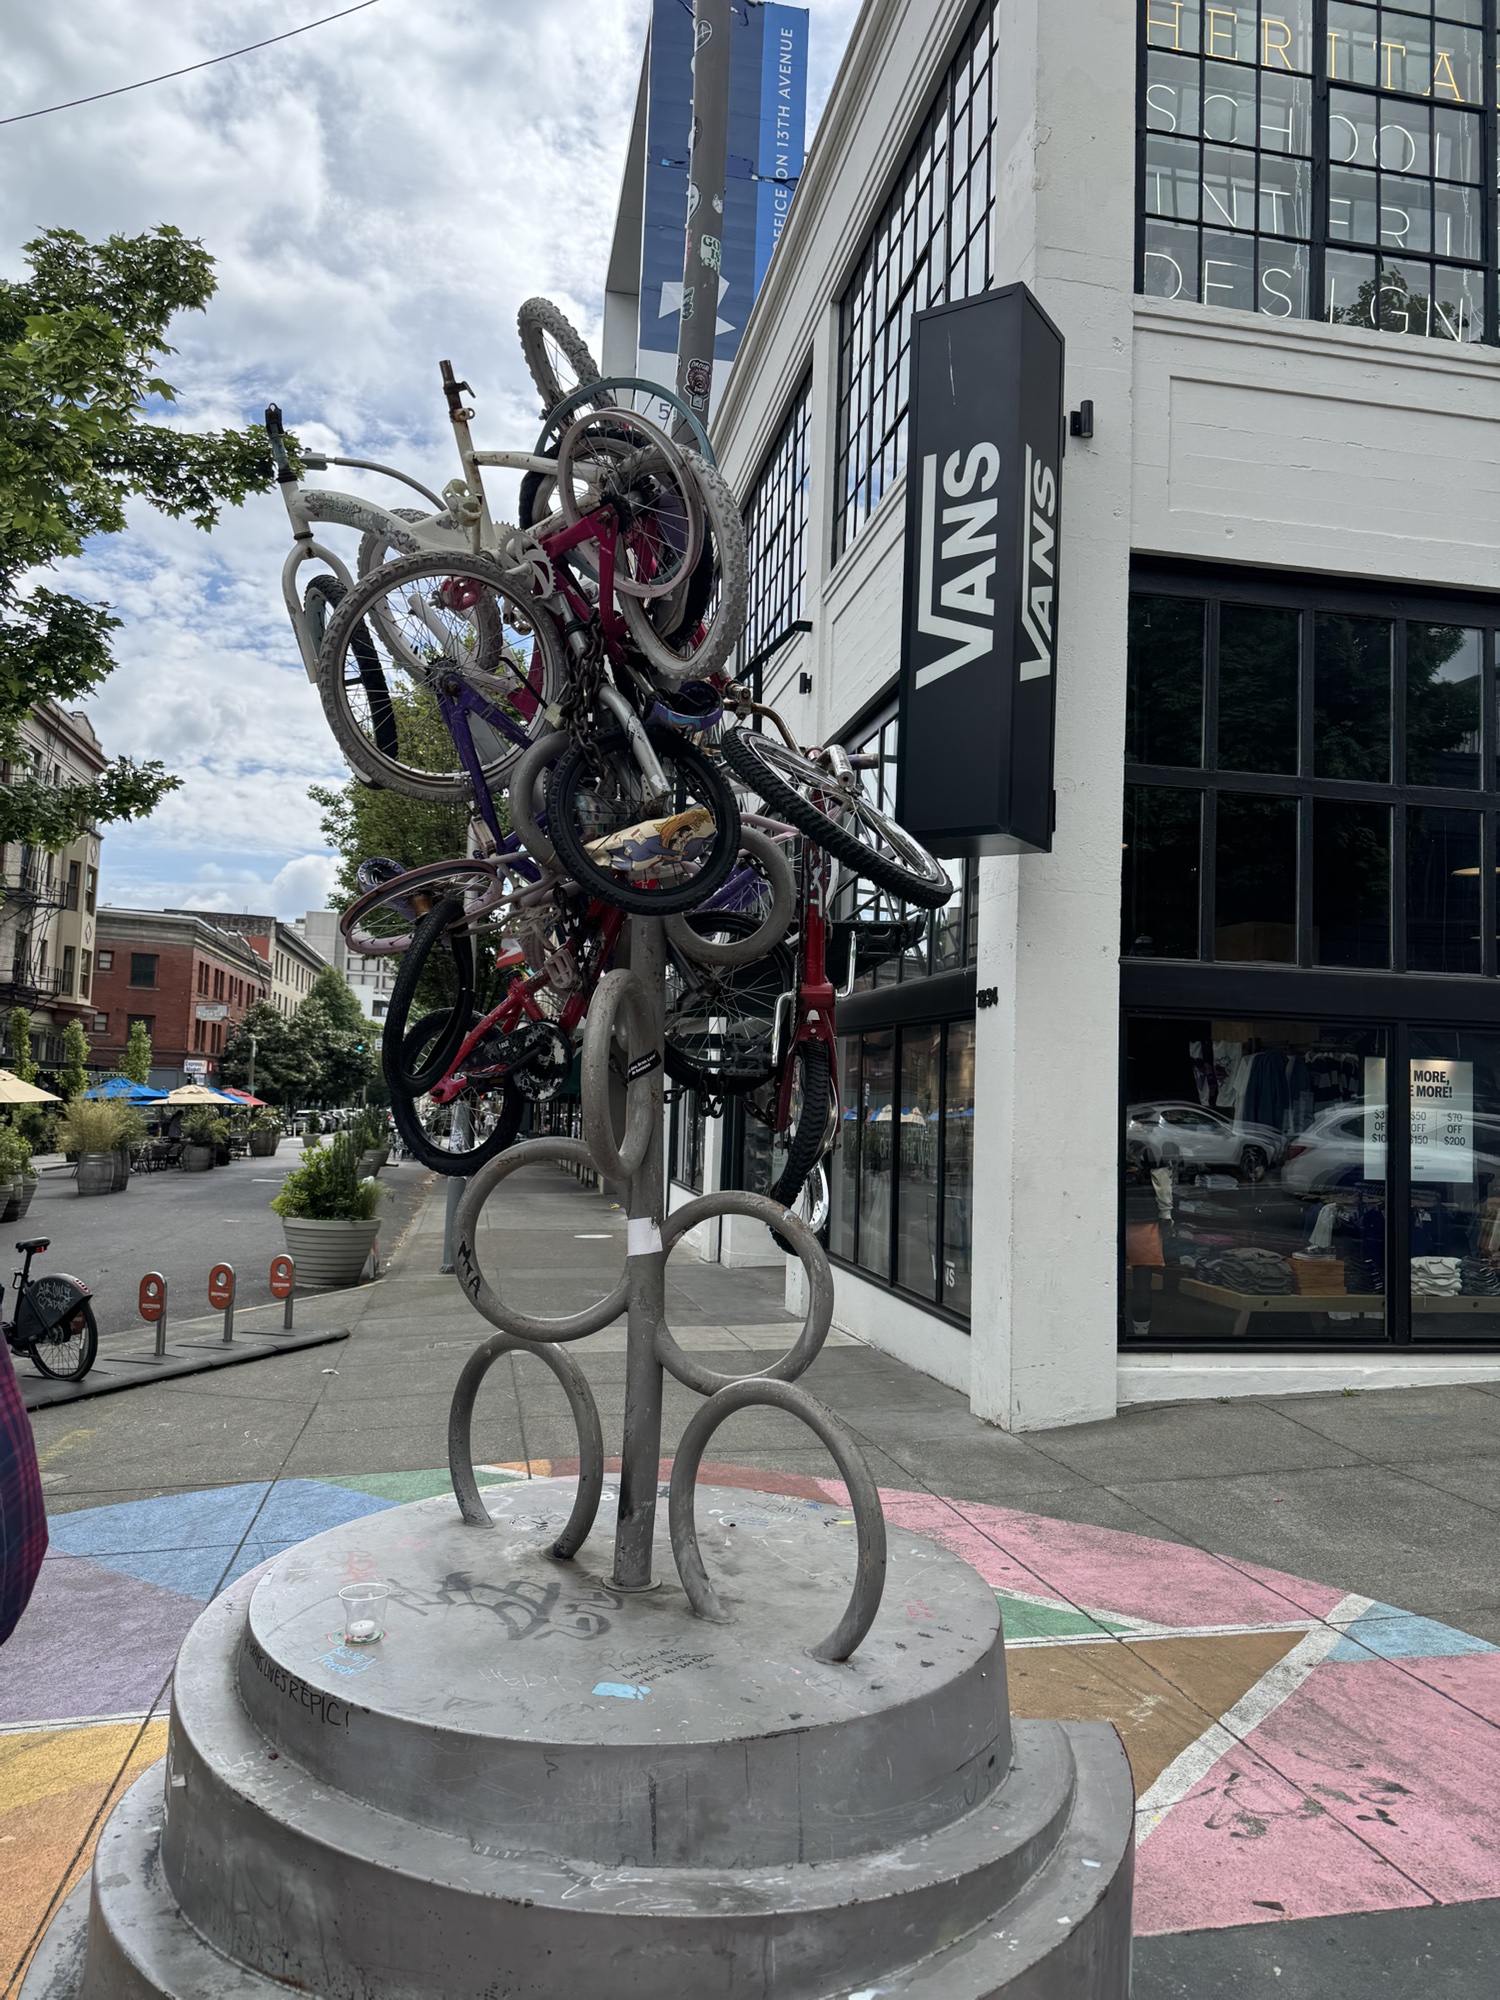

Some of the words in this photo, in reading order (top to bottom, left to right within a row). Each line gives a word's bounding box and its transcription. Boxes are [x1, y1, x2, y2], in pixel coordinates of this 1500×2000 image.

[778, 27, 793, 99] AVENUE
[776, 105, 790, 147] 13TH
[775, 153, 789, 180] ON
[916, 441, 1001, 690] VANS
[1019, 443, 1057, 682] VANS
[1413, 1070, 1450, 1086] MORE,
[1416, 1085, 1453, 1098] MORE!
[1410, 1111, 1427, 1121] $50
[1447, 1112, 1463, 1122] $70
[1411, 1123, 1427, 1133] OFF
[1447, 1124, 1463, 1134] OFF
[1443, 1136, 1466, 1146] $200
